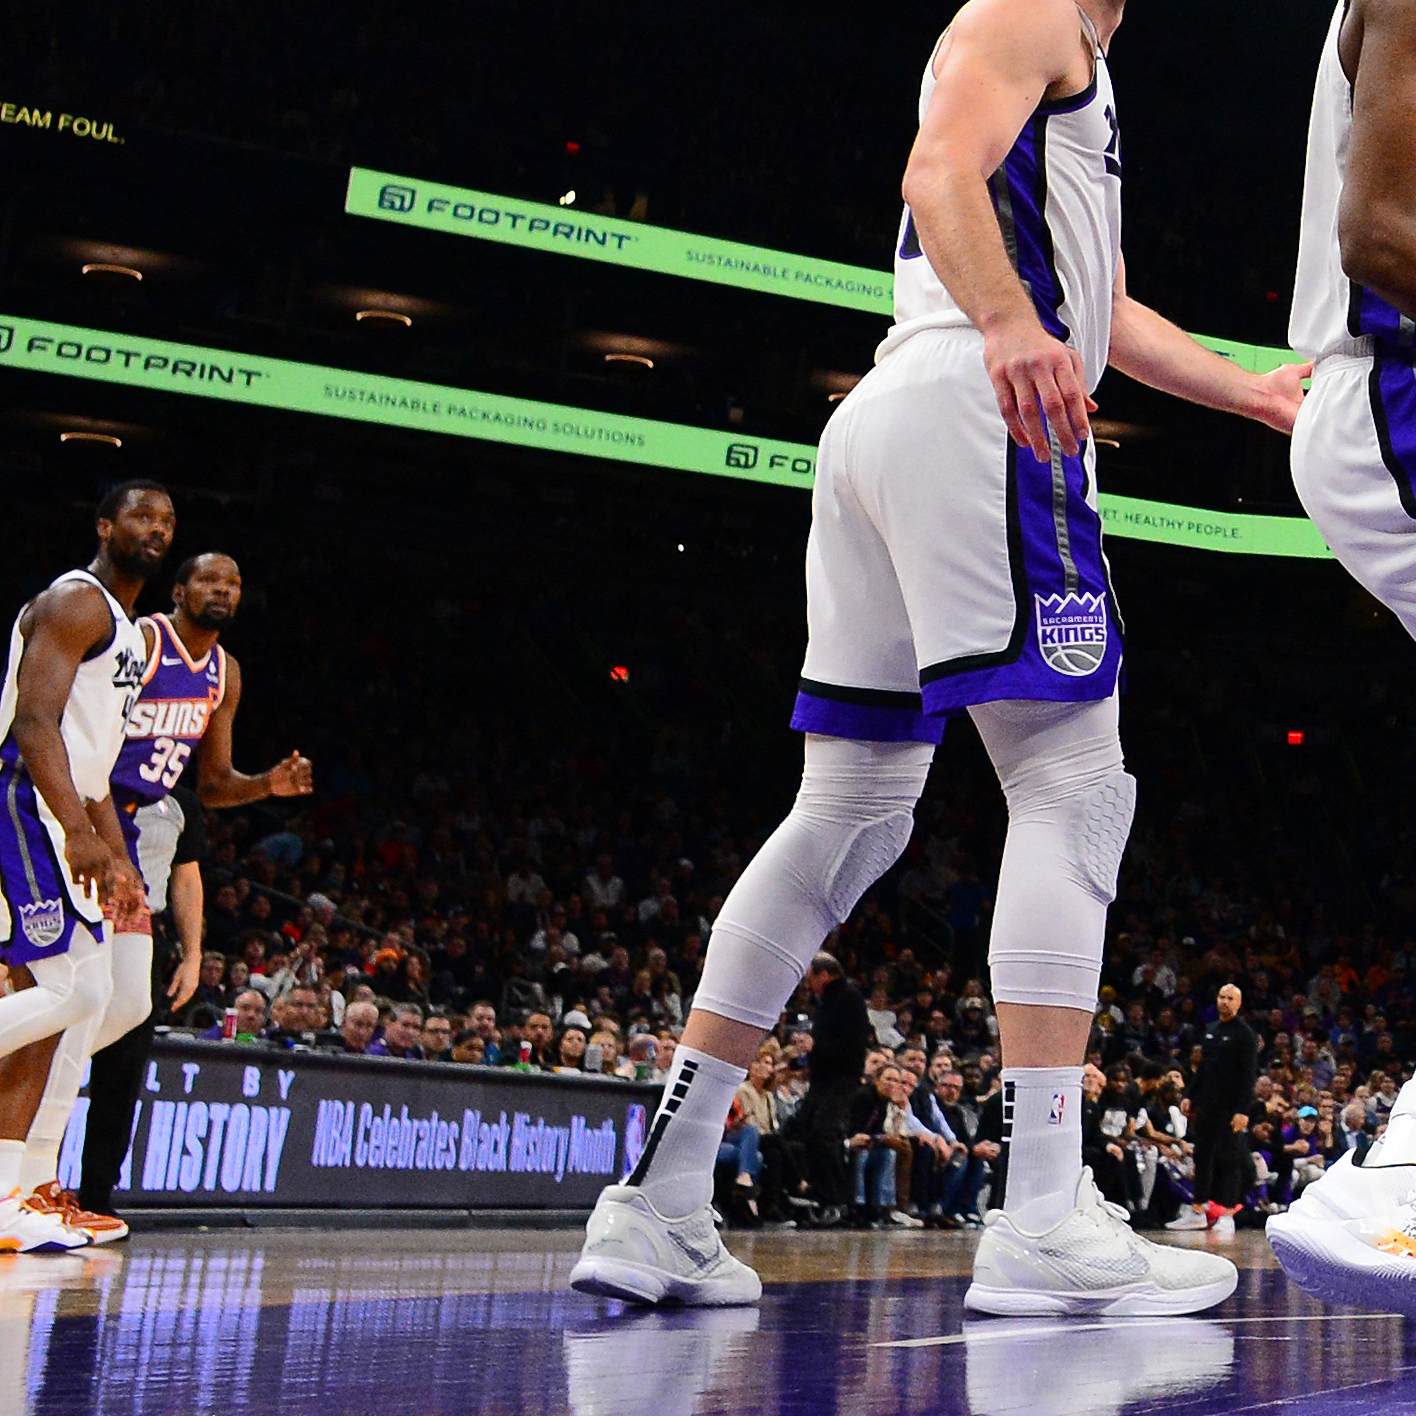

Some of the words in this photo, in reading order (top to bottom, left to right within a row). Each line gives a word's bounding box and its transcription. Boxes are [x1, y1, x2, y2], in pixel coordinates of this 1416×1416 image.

[57, 112, 126, 145] FOUL.
[426, 196, 633, 252] FOOTPRINT
[685, 249, 791, 281] SUSTAINABLE
[794, 270, 884, 299] PACKAGING
[27, 334, 264, 390] FOOTPRINT
[323, 384, 442, 417] SUSTAINABLE
[447, 403, 549, 433] PACKAGING
[551, 418, 646, 448] SOLUTIONS
[1123, 511, 1186, 531] HEALTHY
[1041, 626, 1105, 645] KINGS
[127, 701, 208, 738] SUNS
[139, 736, 191, 790] 35
[141, 1099, 292, 1193] HISTORY
[311, 1098, 356, 1168] NBA
[354, 1102, 459, 1170] Celebrates
[458, 1107, 511, 1172] Black
[508, 1111, 571, 1184] History
[566, 1114, 617, 1175] Month
